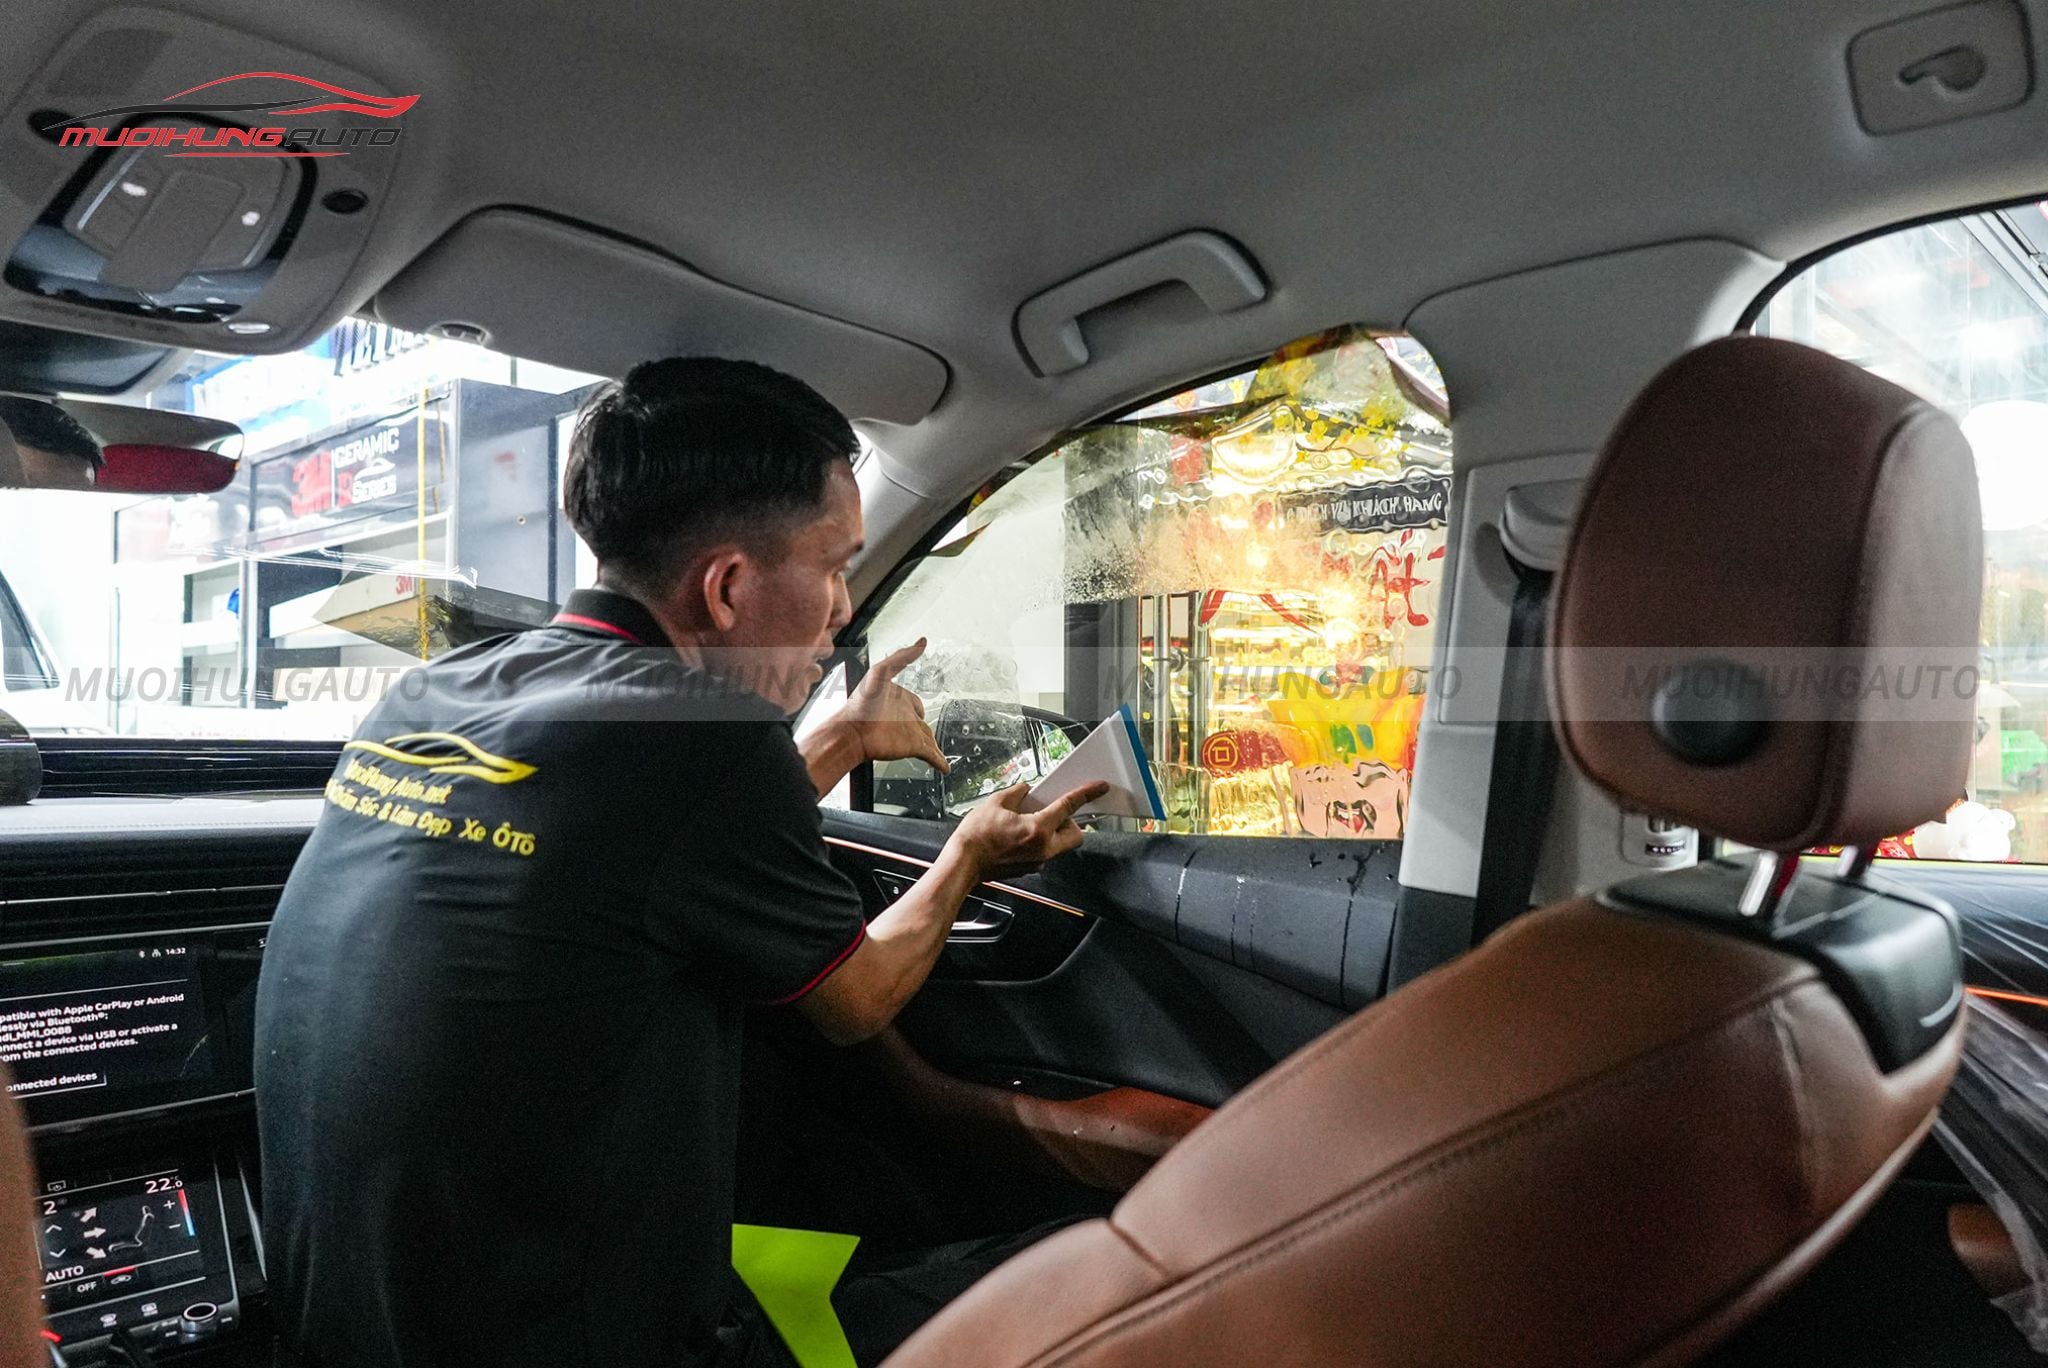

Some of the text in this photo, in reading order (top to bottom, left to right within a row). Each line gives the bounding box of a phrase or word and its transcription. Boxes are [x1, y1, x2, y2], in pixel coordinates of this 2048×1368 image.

[334, 427, 400, 469] CERAMIC
[395, 575, 413, 595] 3M
[457, 817, 487, 843] Xe
[165, 947, 187, 956] 14:32
[38, 1007, 62, 1018] with
[63, 1004, 94, 1015] Apple
[95, 1000, 133, 1010] CarPlay
[133, 999, 145, 1007] or
[146, 993, 185, 1005] Android
[30, 1020, 46, 1029] via
[35, 1040, 42, 1048] a
[44, 1036, 77, 1047] device
[78, 1033, 94, 1042] via
[95, 1029, 117, 1040] USB
[118, 1029, 130, 1037] or
[130, 1024, 170, 1035] activate
[171, 1023, 178, 1031] a
[22, 1050, 41, 1059] the
[43, 1042, 97, 1056] connected
[98, 1038, 139, 1049] devices.
[59, 1072, 98, 1085] devices
[45, 1265, 84, 1283] AUTO
[77, 1281, 97, 1293] OFF
